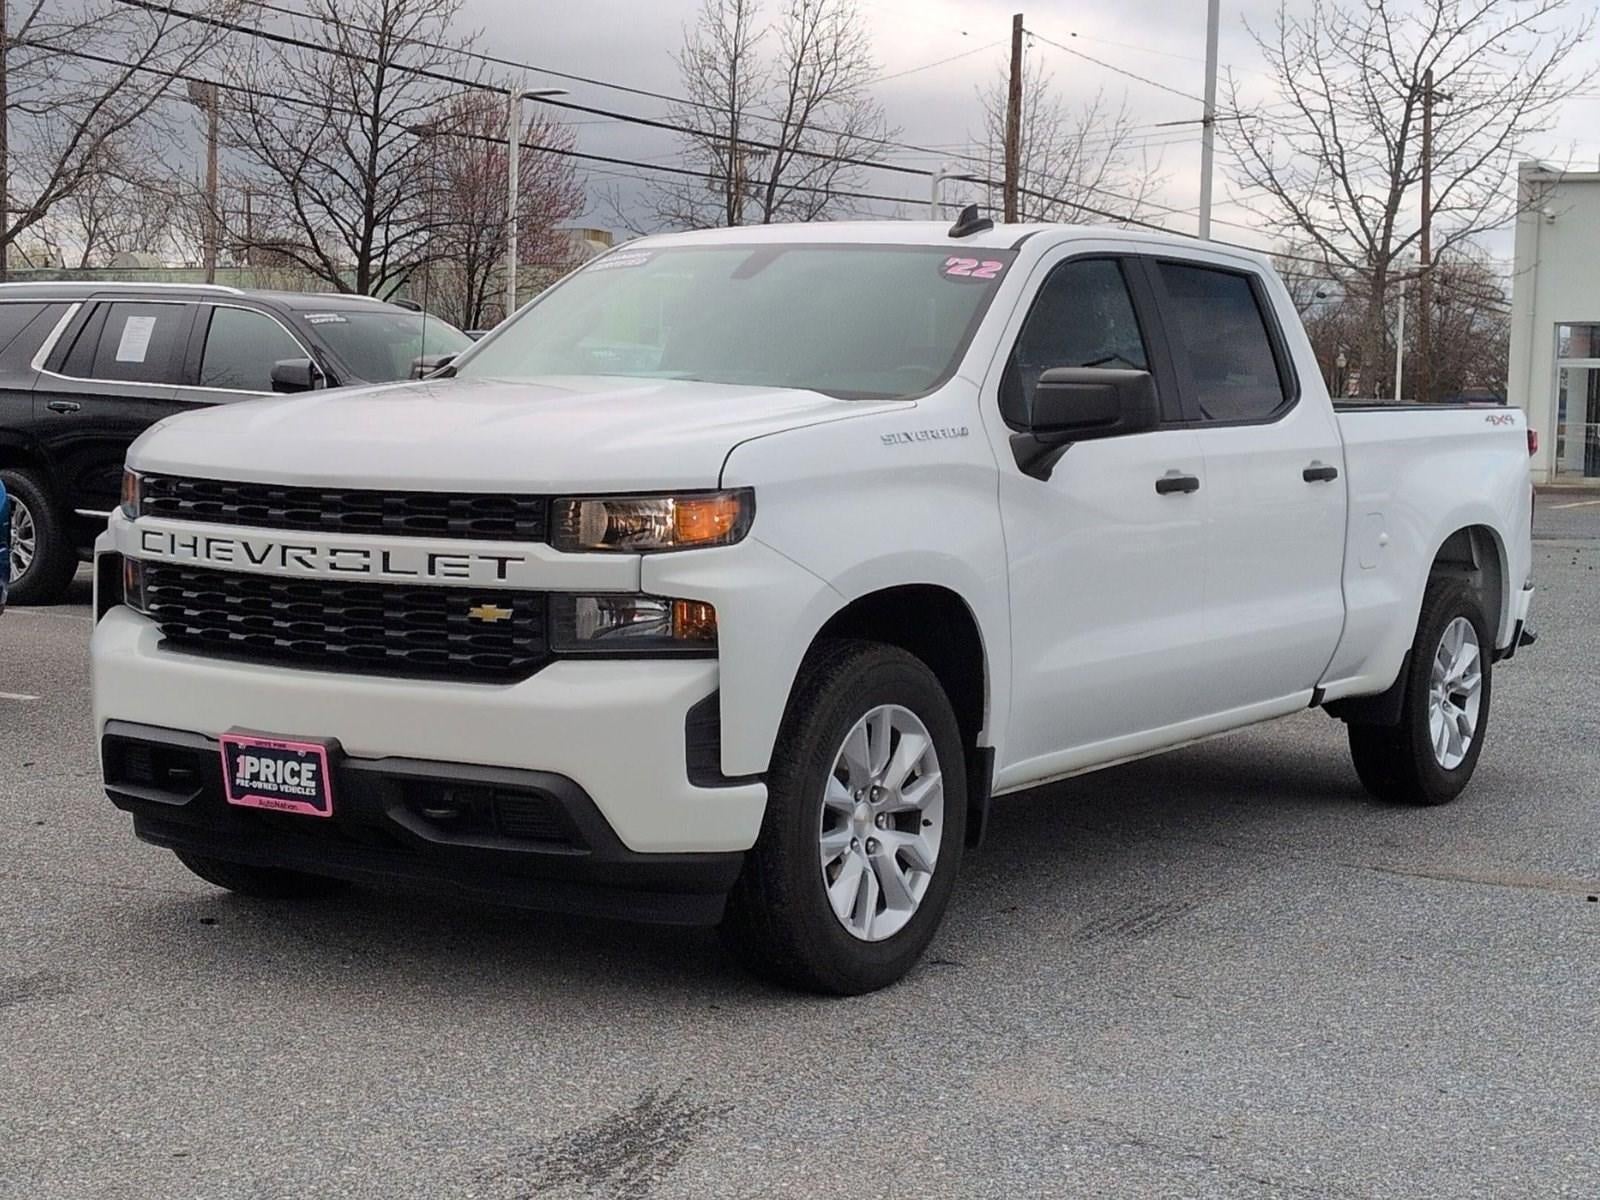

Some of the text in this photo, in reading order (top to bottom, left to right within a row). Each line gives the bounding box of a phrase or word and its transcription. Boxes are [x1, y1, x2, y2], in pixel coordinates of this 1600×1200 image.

[881, 426, 969, 446] SILVERADO
[141, 530, 525, 579] CHEVROLET
[280, 783, 316, 796] VEHICLES
